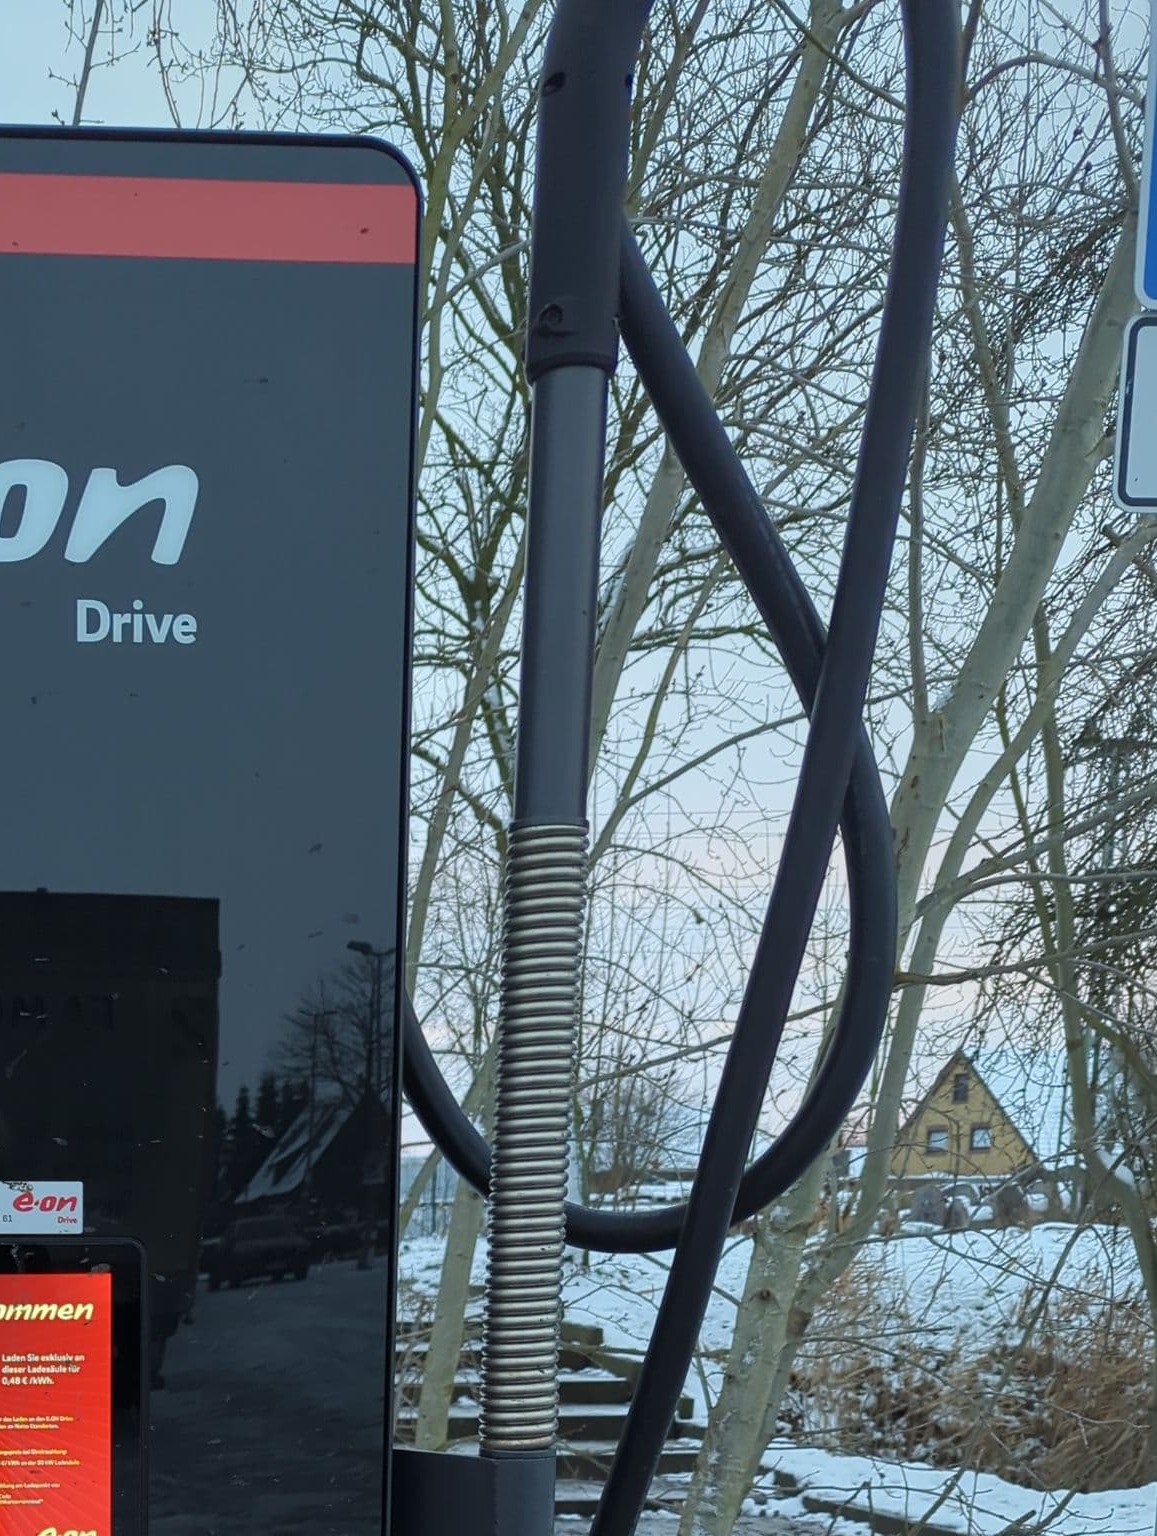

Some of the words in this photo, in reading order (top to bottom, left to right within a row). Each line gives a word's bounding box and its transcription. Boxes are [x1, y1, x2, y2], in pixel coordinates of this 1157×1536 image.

[77, 599, 197, 644] Drive
[2, 1214, 13, 1223] 61
[1, 1353, 26, 1362] Laden
[27, 1353, 39, 1362] Sie
[41, 1352, 74, 1362] exklusiv
[74, 1354, 85, 1362] an
[1, 1365, 26, 1373] dieser
[27, 1364, 67, 1373] Ladesäule
[68, 1364, 81, 1373] für
[1, 1376, 20, 1385] 0,48
